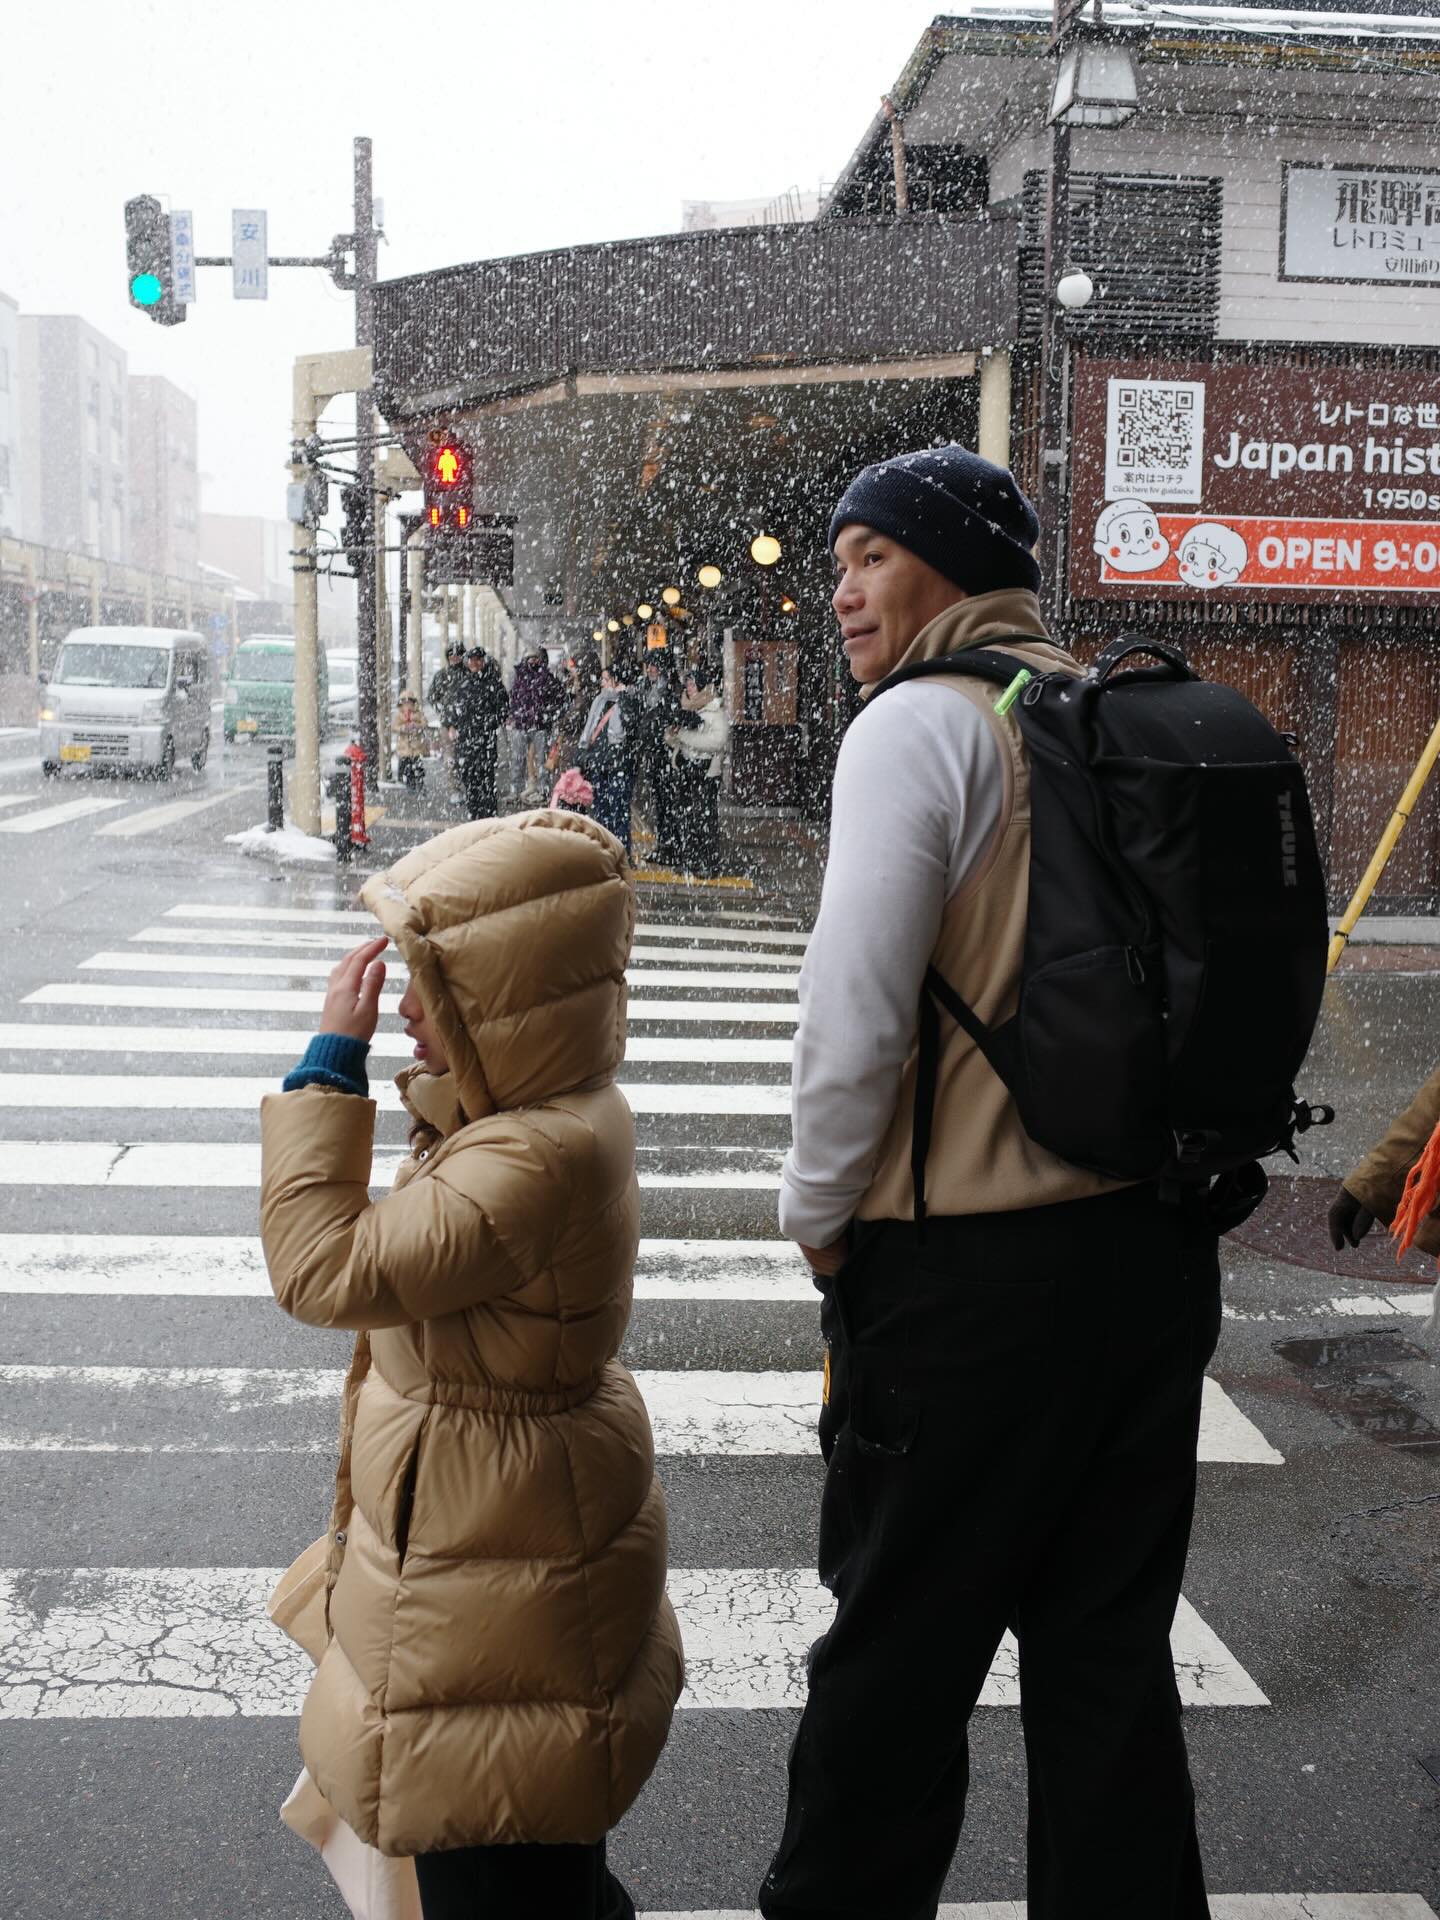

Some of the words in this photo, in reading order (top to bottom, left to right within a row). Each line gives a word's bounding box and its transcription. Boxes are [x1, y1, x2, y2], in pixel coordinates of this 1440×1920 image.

[240, 223, 259, 288] 安川
[1320, 400, 1440, 428] レトロな世
[1214, 432, 1353, 479] Japan
[1364, 437, 1440, 475] hist
[1112, 485, 1130, 493] Click
[1133, 486, 1148, 495] here
[1149, 487, 1160, 495] for
[1161, 487, 1194, 497] guidance
[1124, 472, 1184, 485] 案内はコチラ
[1363, 488, 1440, 511] 1950s
[1258, 536, 1361, 571] OPEN
[1373, 540, 1440, 573] 9:0
[1278, 791, 1297, 886] THULE
